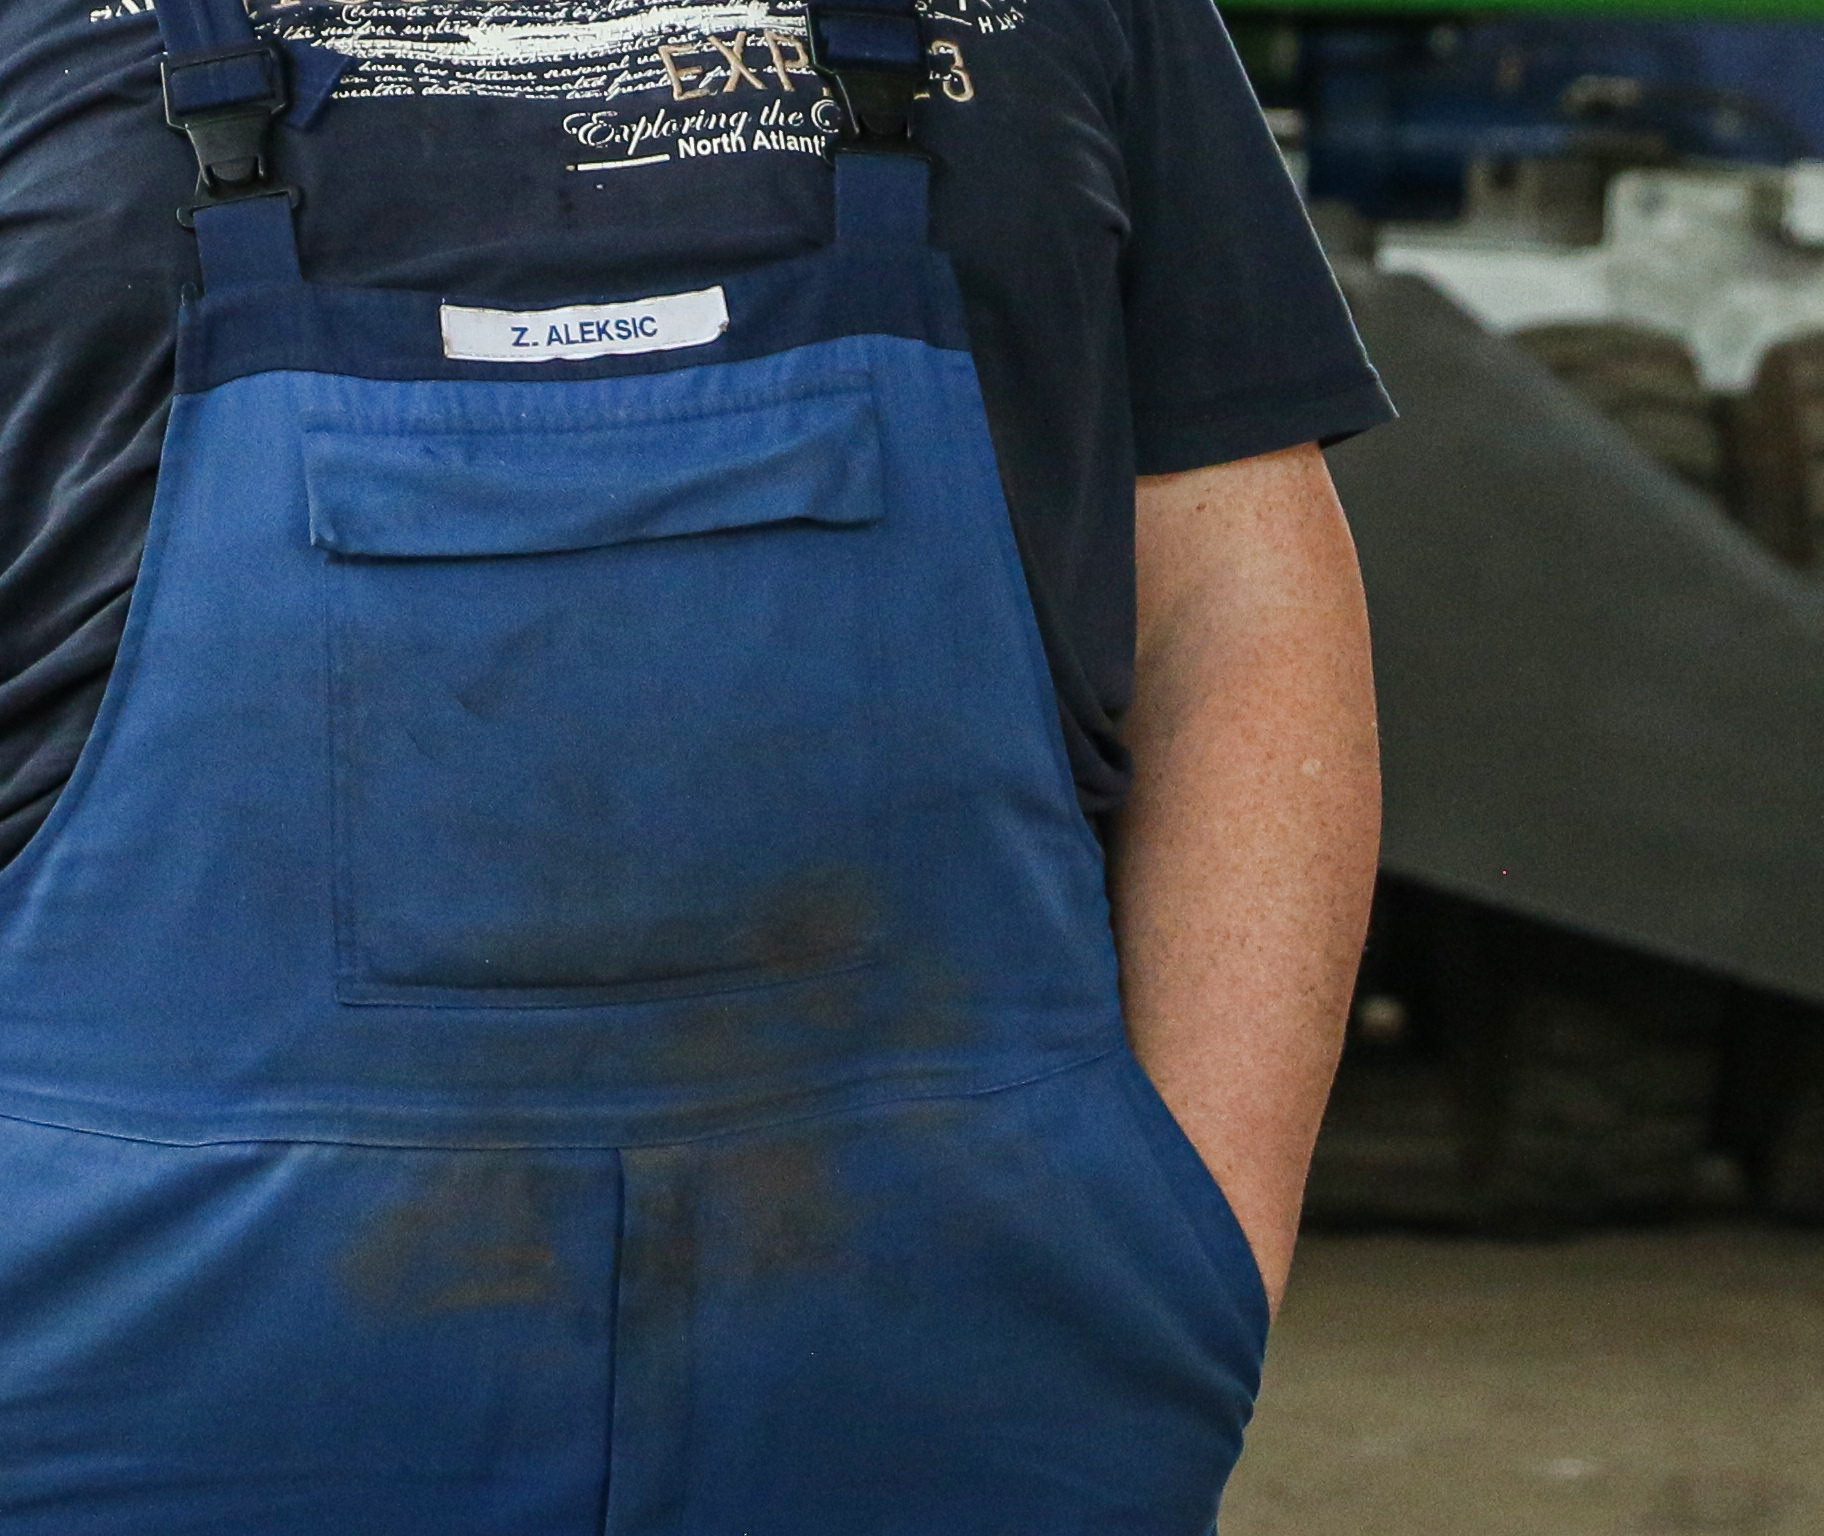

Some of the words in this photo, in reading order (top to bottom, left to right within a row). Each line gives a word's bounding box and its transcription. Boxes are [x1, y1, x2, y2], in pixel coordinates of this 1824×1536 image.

[760, 99, 804, 126] the
[678, 131, 746, 158] North
[511, 327, 539, 347] Z.
[546, 316, 658, 346] ALEKSIC
